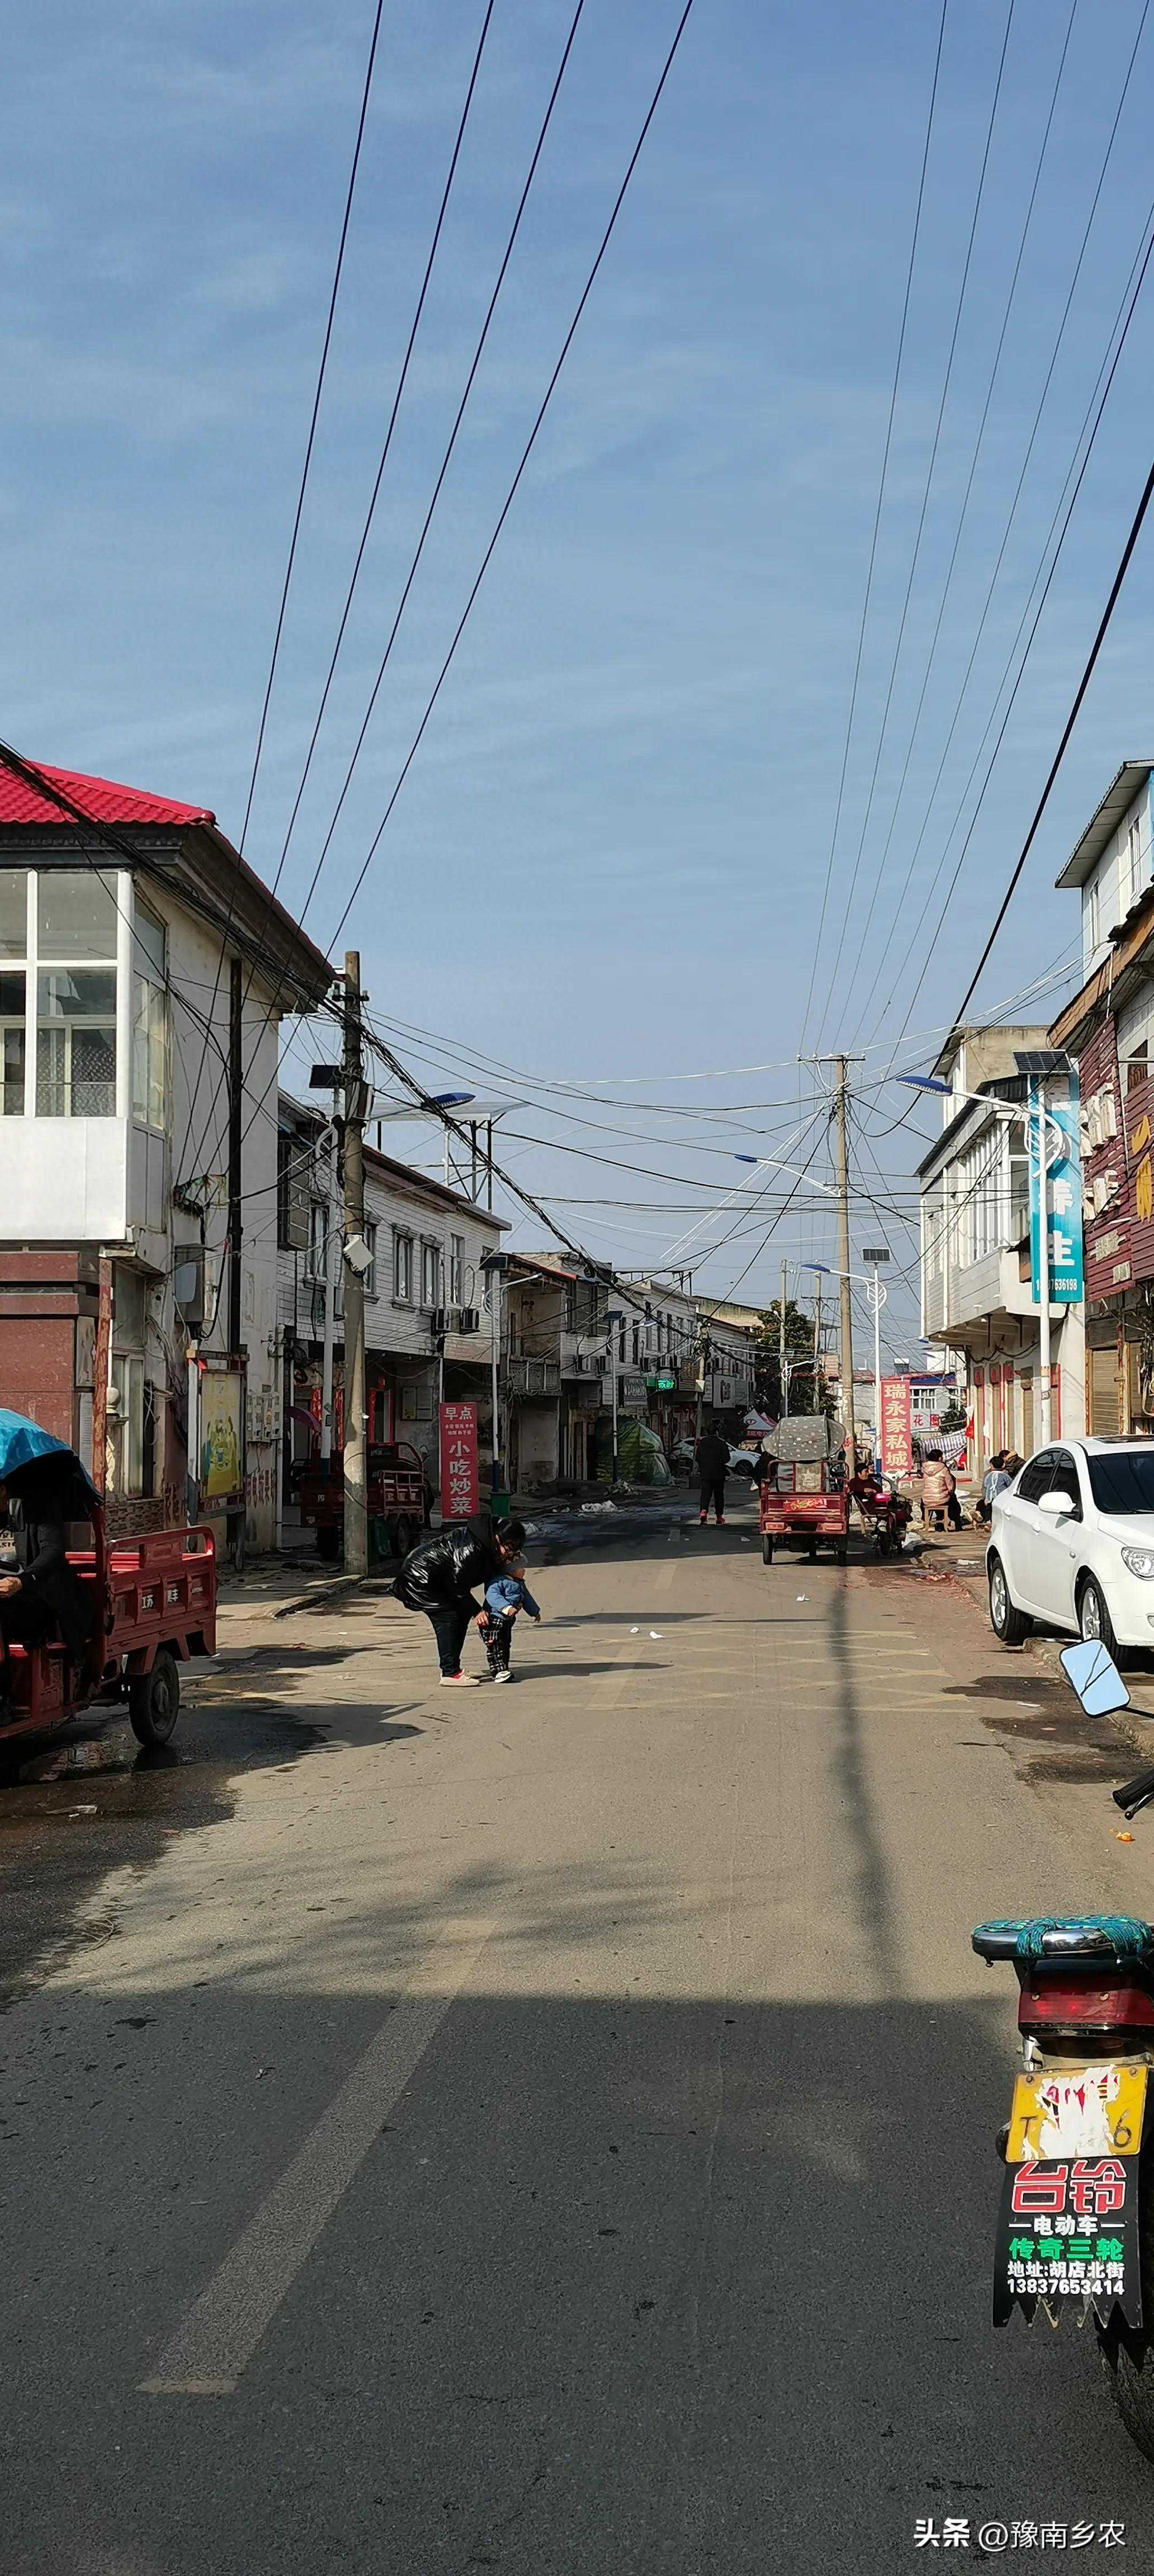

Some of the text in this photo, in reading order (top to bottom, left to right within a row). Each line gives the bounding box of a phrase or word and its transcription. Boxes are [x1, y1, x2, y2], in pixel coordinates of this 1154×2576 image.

[1035, 1278, 1077, 1291] 137636198
[444, 1406, 472, 1420] 早点
[884, 1384, 909, 1466] 瑞永家私城
[449, 1441, 472, 1514] 小吃炒菜
[1011, 2159, 1126, 2214] 台铃
[1033, 2215, 1098, 2237] 电动车
[1009, 2238, 1125, 2261] 传奇三轮
[1007, 2261, 1125, 2280] 地址:胡店北街
[1007, 2279, 1125, 2295] 13837653414
